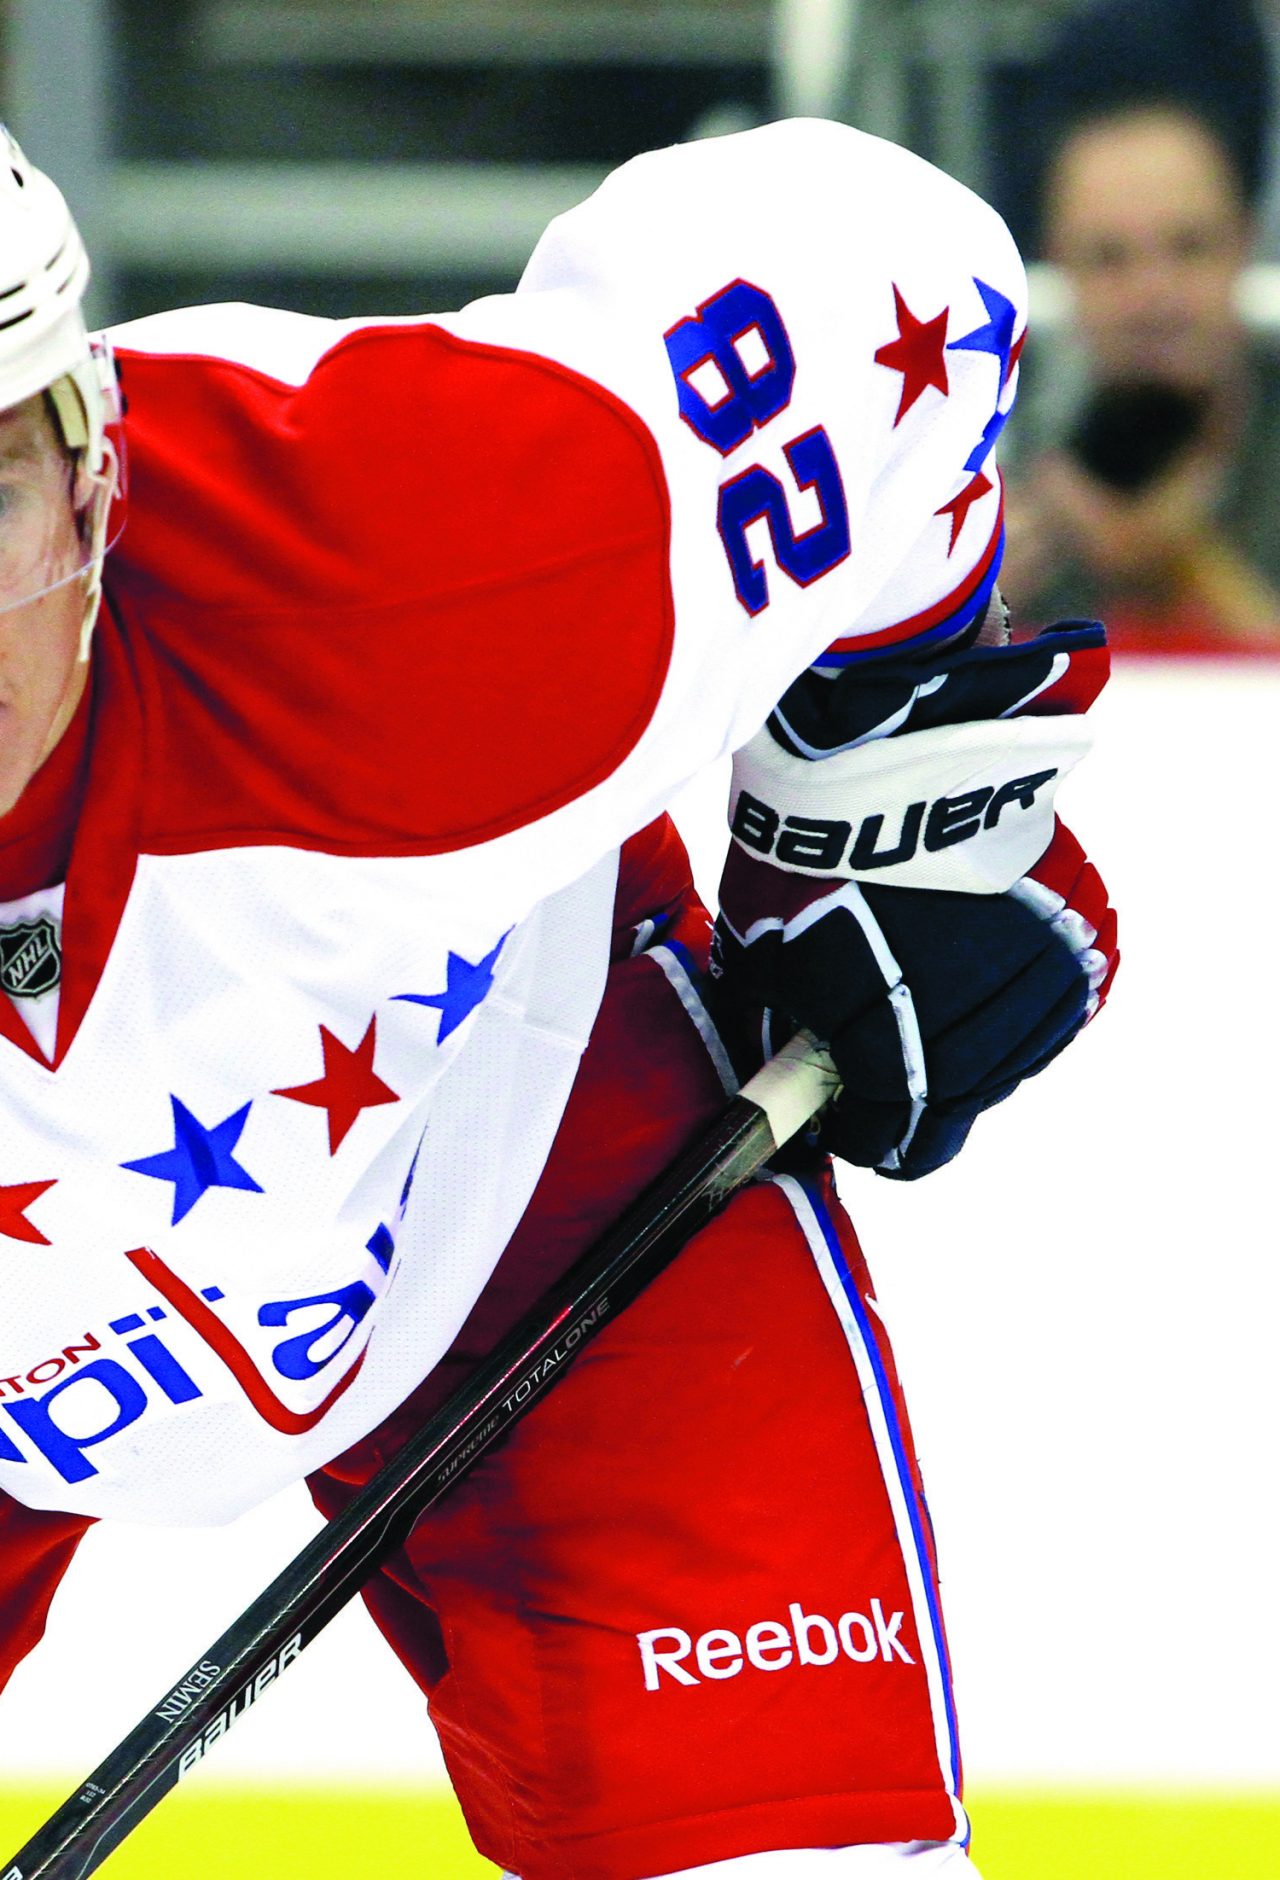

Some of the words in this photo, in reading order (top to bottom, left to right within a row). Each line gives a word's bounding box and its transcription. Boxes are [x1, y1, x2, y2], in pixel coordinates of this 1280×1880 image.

[663, 277, 851, 619] 28
[8, 936, 48, 987] NHL
[635, 1597, 917, 1692] Reebok
[155, 1659, 221, 1723] SEMIN
